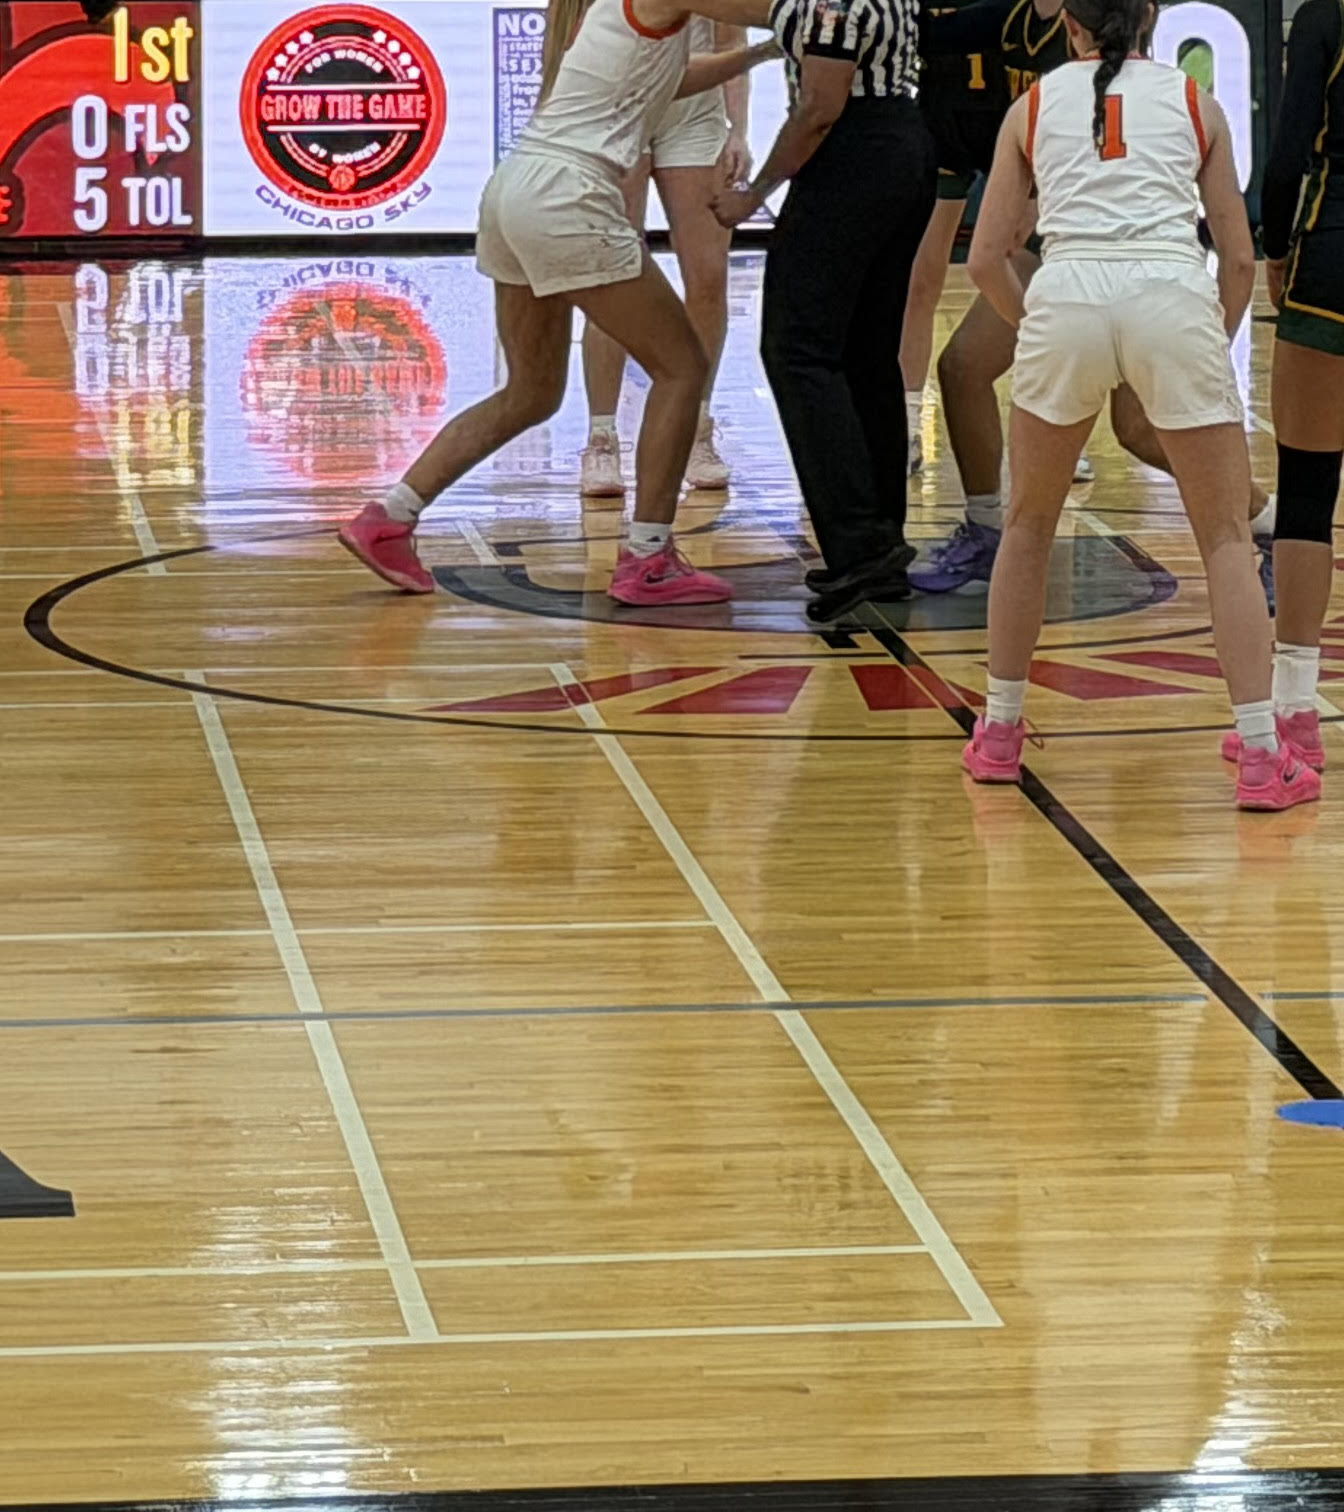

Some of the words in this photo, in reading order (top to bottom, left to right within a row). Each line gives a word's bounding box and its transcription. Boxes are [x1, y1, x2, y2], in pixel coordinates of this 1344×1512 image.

[113, 6, 194, 83] 1st
[498, 12, 546, 36] NO
[966, 52, 986, 89] 1
[71, 94, 108, 160] 0
[125, 103, 191, 153] FLS
[261, 94, 320, 121] GROW
[325, 94, 364, 120] THE
[368, 94, 427, 120] GAME
[1099, 93, 1127, 162] 1
[73, 167, 108, 233] 5
[122, 176, 193, 226] TOL
[256, 184, 374, 230] CHICAGO
[384, 181, 433, 223] SKY
